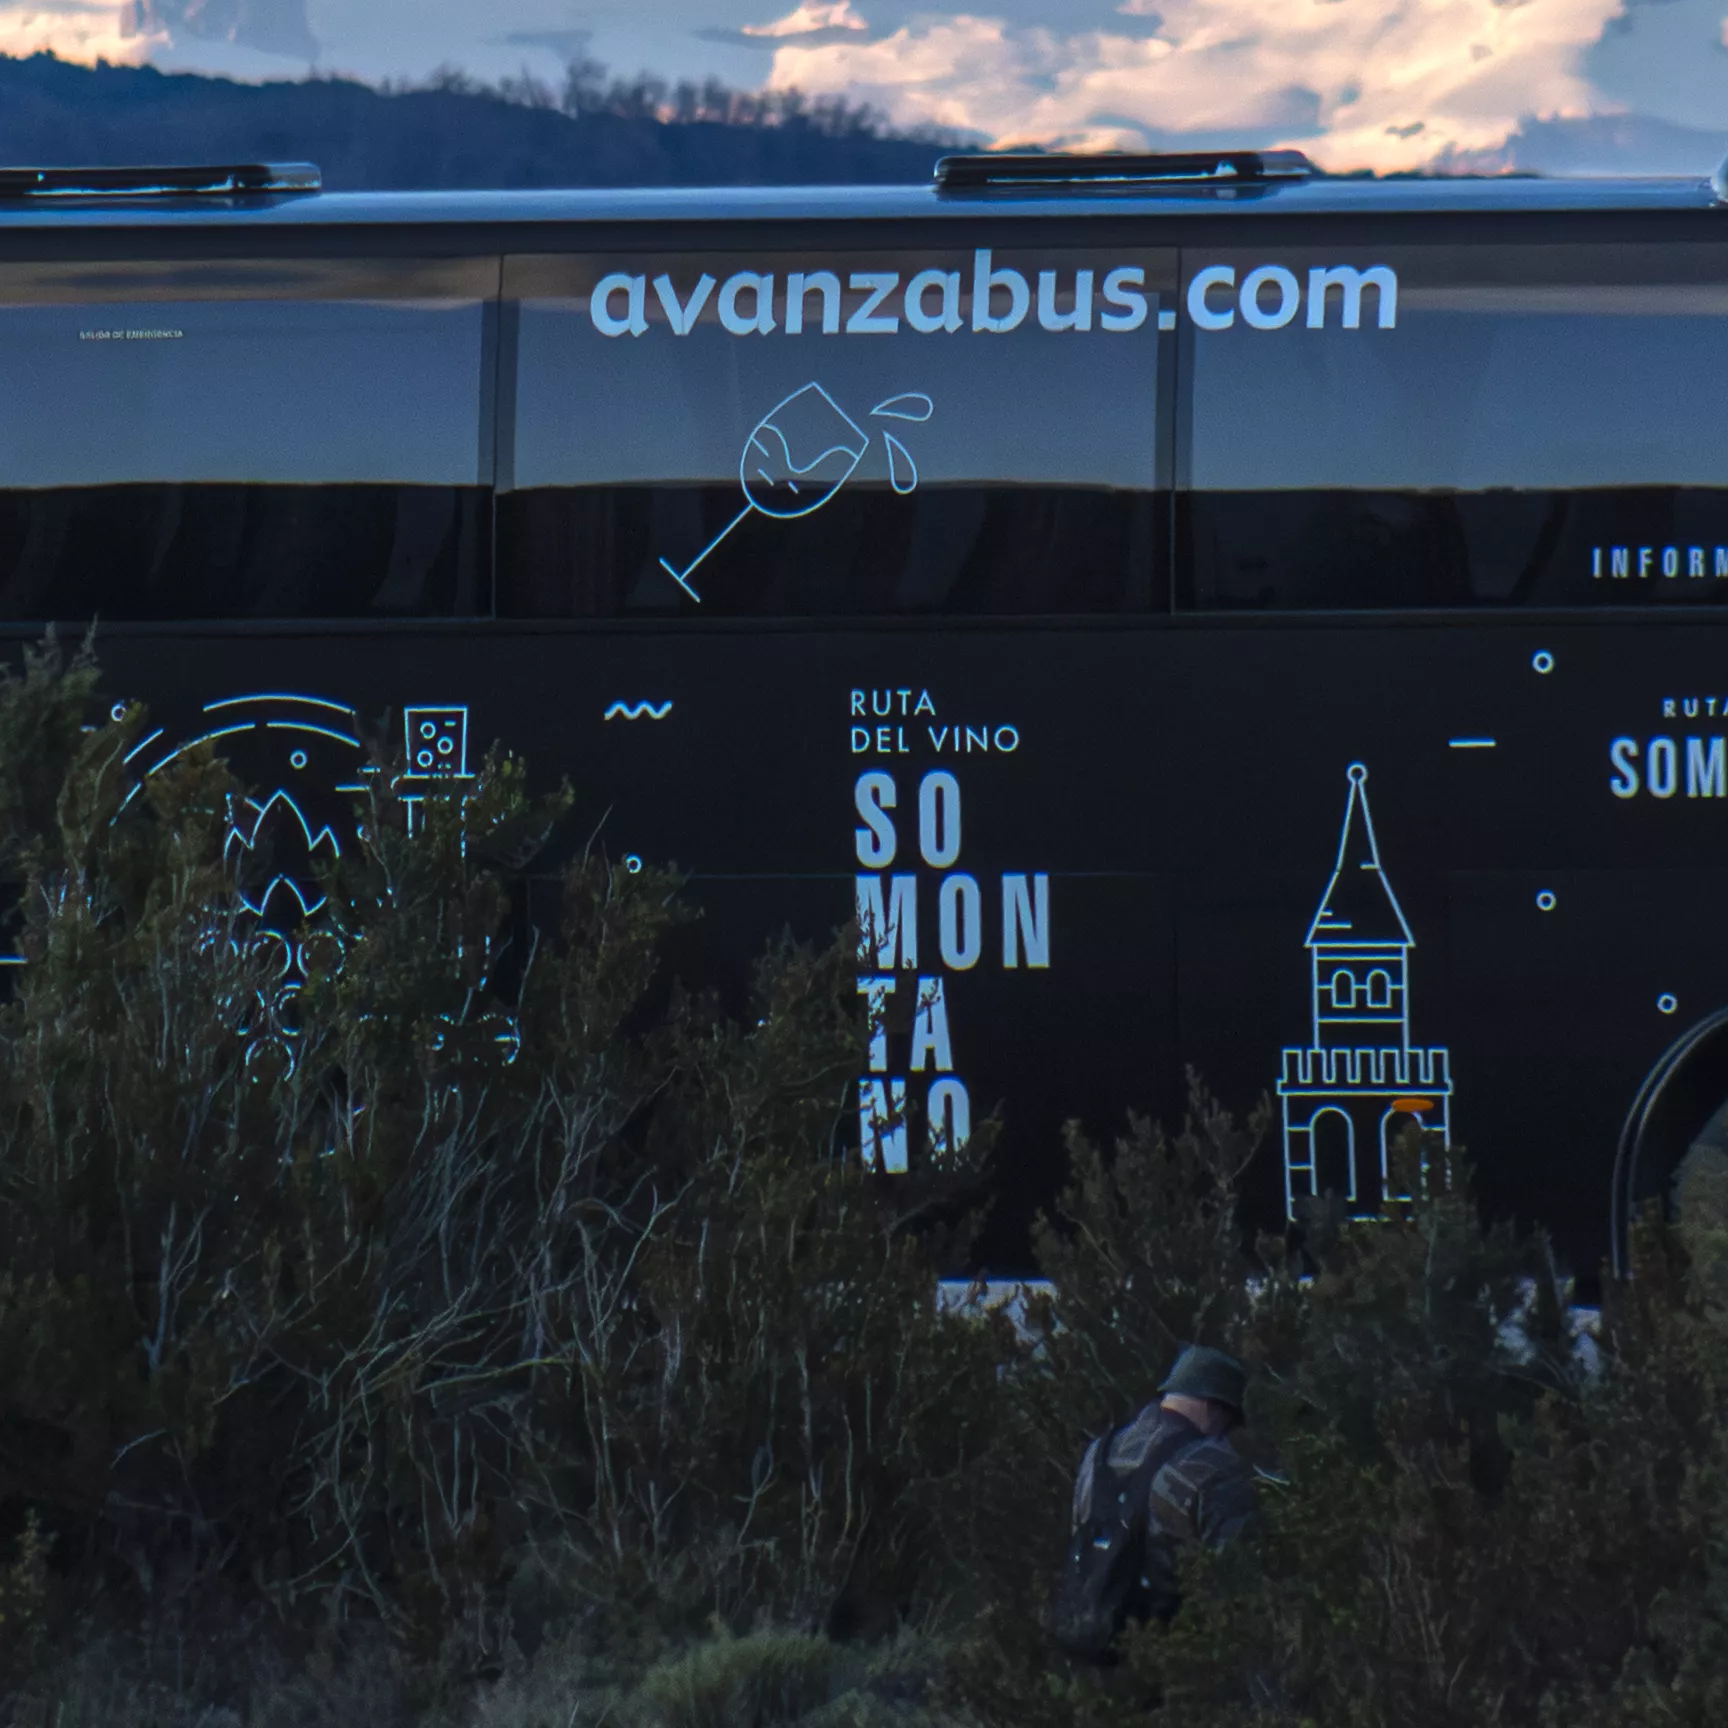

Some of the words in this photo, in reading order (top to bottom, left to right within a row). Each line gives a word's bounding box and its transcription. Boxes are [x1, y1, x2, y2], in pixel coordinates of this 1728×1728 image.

[591, 248, 1397, 336] avanzabus.com
[852, 689, 935, 715] RUTA
[852, 726, 908, 752] DEL
[929, 725, 1018, 752] VINO
[855, 770, 960, 867] SO
[857, 872, 1048, 968] MON
[857, 975, 952, 1071] TA
[860, 1076, 969, 1172] NO
